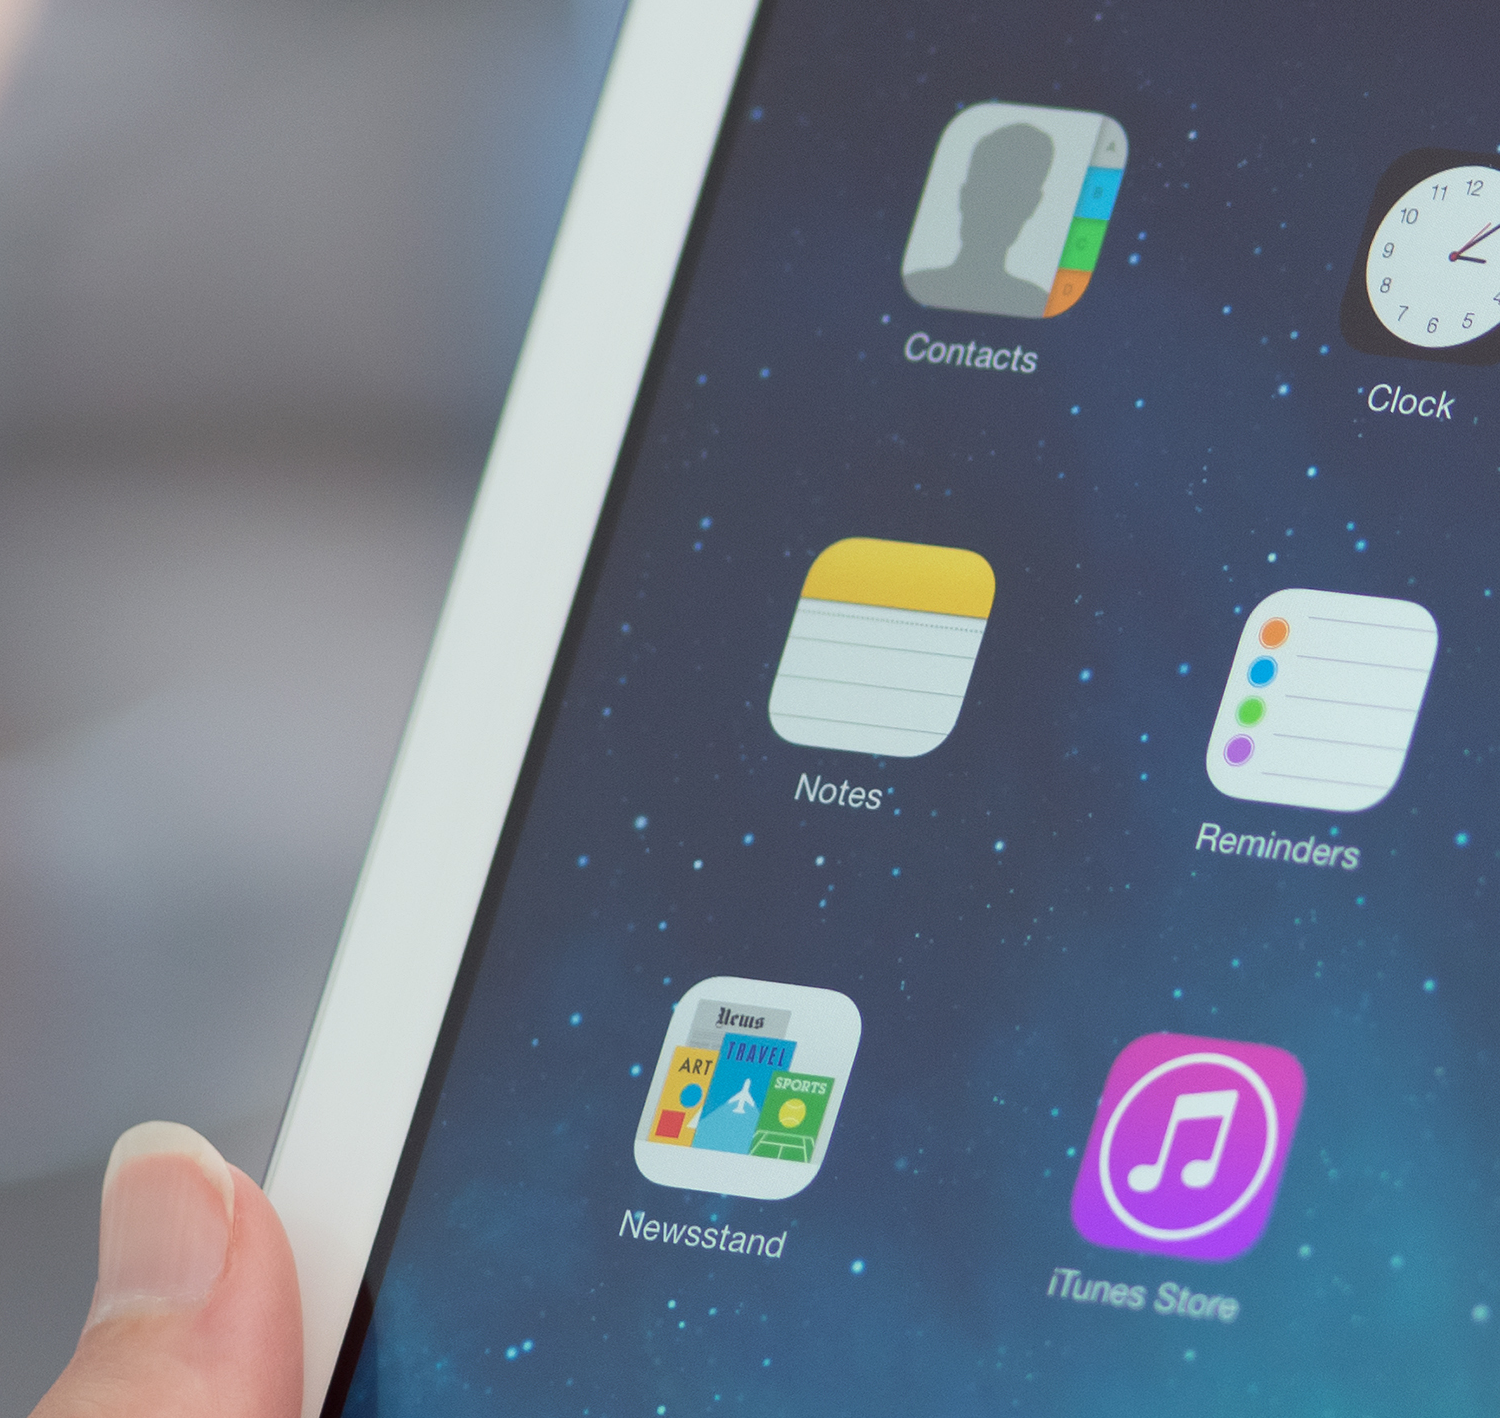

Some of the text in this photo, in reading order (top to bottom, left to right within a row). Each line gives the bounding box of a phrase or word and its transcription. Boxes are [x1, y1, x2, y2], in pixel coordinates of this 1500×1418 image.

[1431, 184, 1449, 202] 11
[1465, 180, 1485, 198] 12
[1400, 207, 1420, 225] 10
[1381, 242, 1395, 259] 9
[1379, 276, 1393, 294] 8
[1396, 304, 1410, 322] 7
[1461, 312, 1475, 330] 5
[1426, 317, 1440, 334] 6
[903, 331, 1039, 374] Contacts
[1367, 383, 1456, 420] Clock
[793, 772, 884, 811] Notes
[1194, 822, 1361, 870] Reminders
[715, 1006, 766, 1030] News
[726, 1041, 786, 1067] TRAVEL
[678, 1056, 714, 1076] ART
[774, 1076, 828, 1095] SPORTS
[618, 1209, 788, 1259] Newsstand
[1046, 1268, 1241, 1323] iTunes Store
